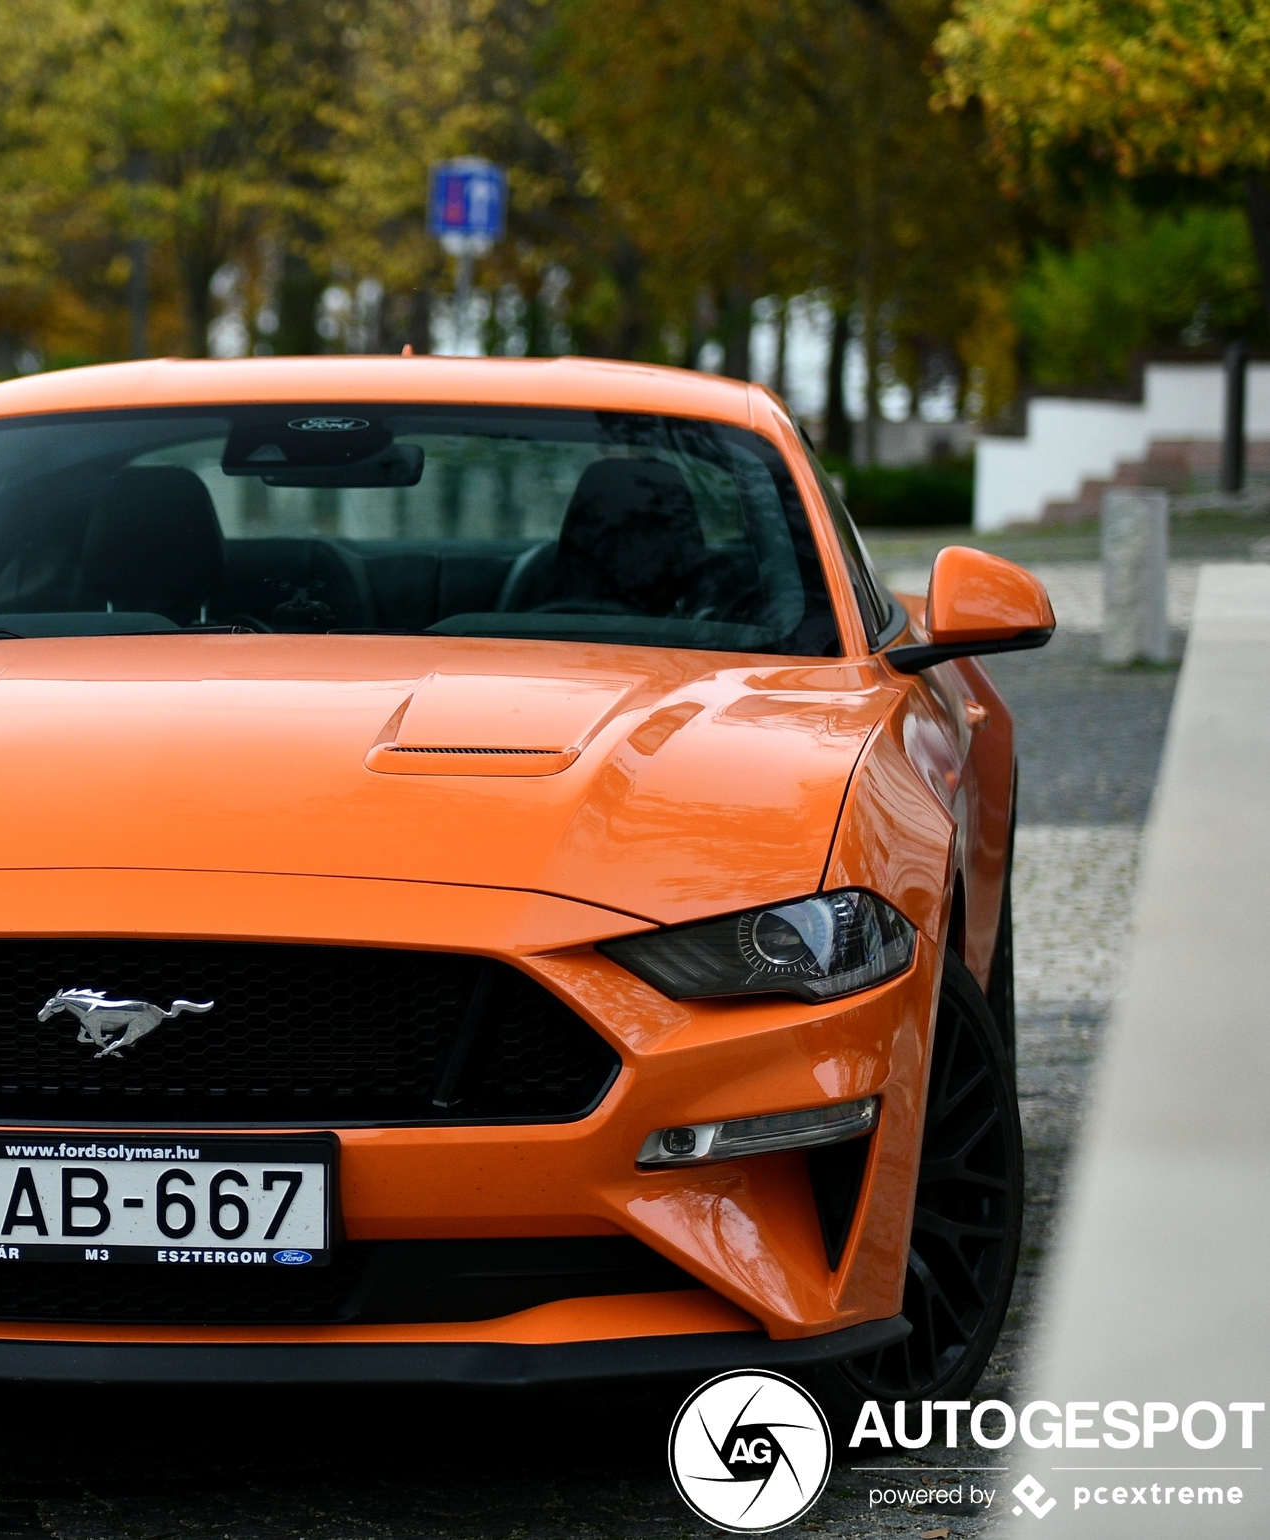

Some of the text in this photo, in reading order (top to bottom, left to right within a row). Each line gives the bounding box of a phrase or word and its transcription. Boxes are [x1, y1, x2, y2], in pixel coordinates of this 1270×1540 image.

[301, 417, 356, 430] Ford
[5, 1142, 200, 1161] www.fordsolymar.hu
[85, 1249, 110, 1261] M3
[157, 1250, 267, 1264] ESZTERGOM
[280, 1251, 305, 1263] Ford
